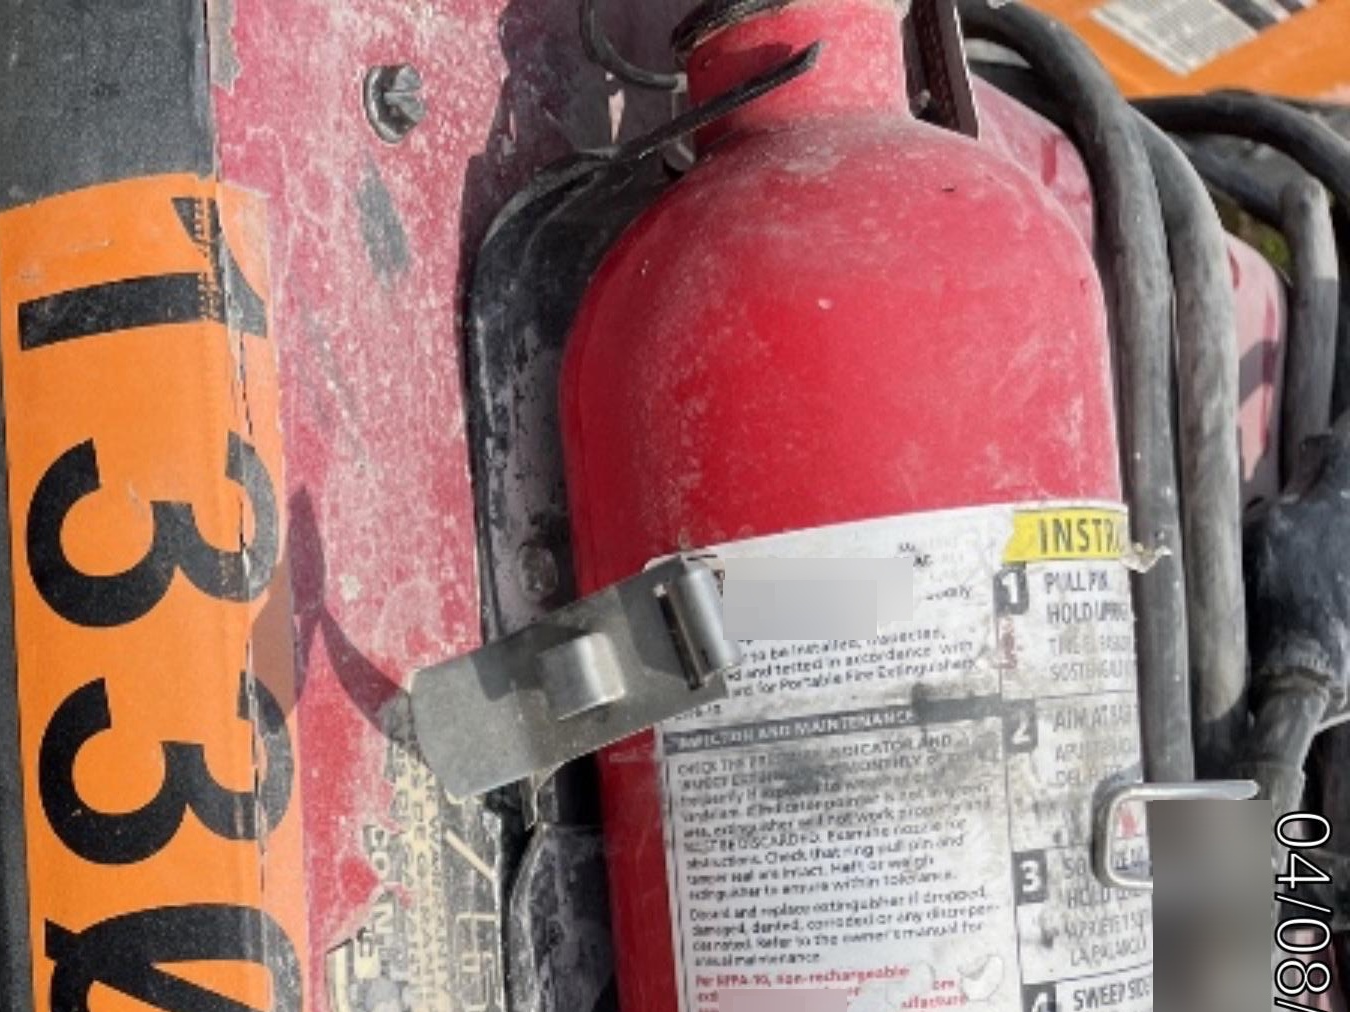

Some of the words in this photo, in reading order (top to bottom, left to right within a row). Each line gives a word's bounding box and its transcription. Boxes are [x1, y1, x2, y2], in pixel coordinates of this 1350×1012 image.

[1038, 518, 1123, 555] INSTR
[1002, 572, 1020, 604] 1
[1043, 569, 1087, 594] PULL
[1046, 601, 1092, 625] HOLD
[1012, 718, 1031, 745] 2
[1019, 859, 1043, 893] 3
[1073, 983, 1126, 1012] SWEEP
